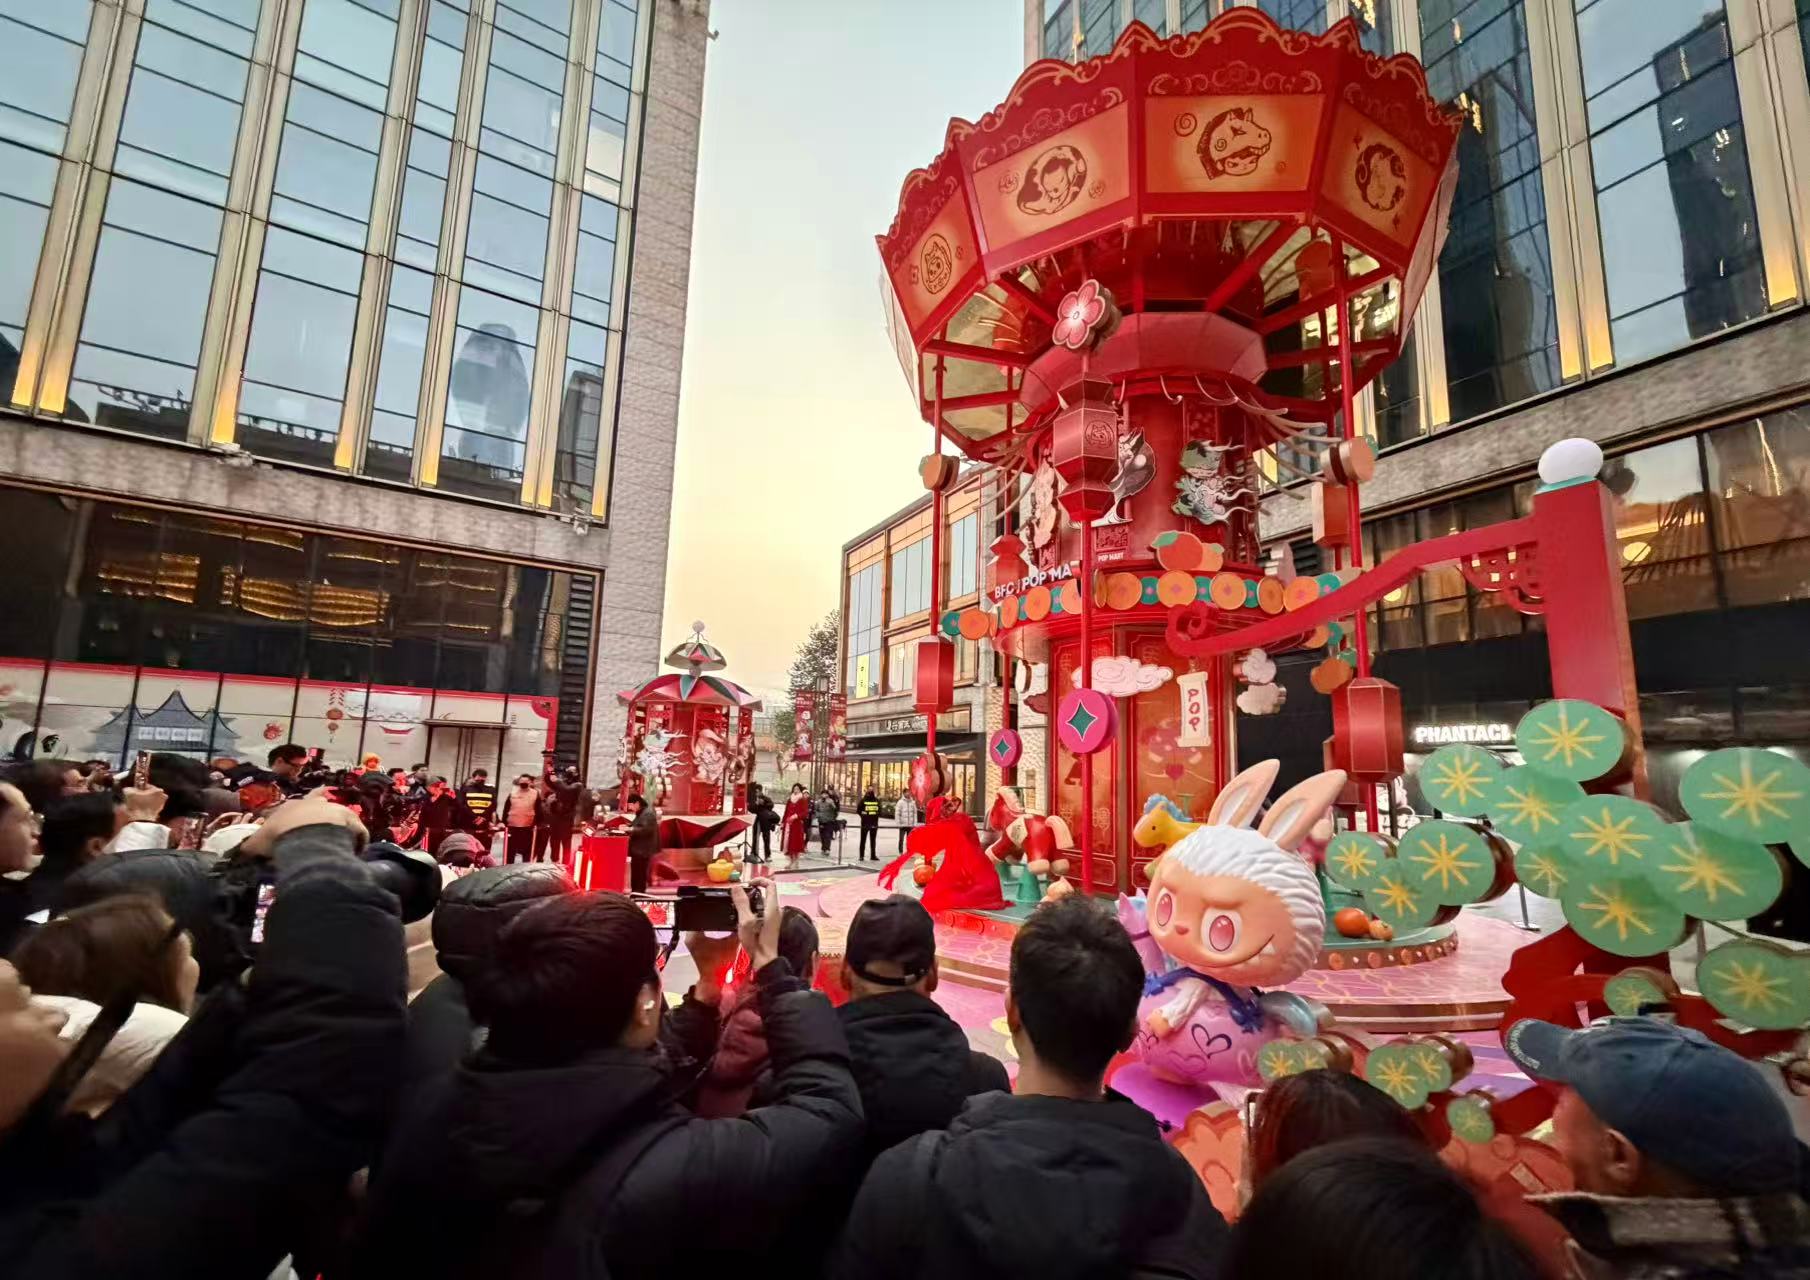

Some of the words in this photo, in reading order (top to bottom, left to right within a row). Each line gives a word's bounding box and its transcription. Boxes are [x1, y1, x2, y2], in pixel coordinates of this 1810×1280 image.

[995, 582, 1015, 599] BFC
[1021, 569, 1048, 592] POP
[1050, 563, 1073, 582] MA
[1188, 688, 1201, 732] POP
